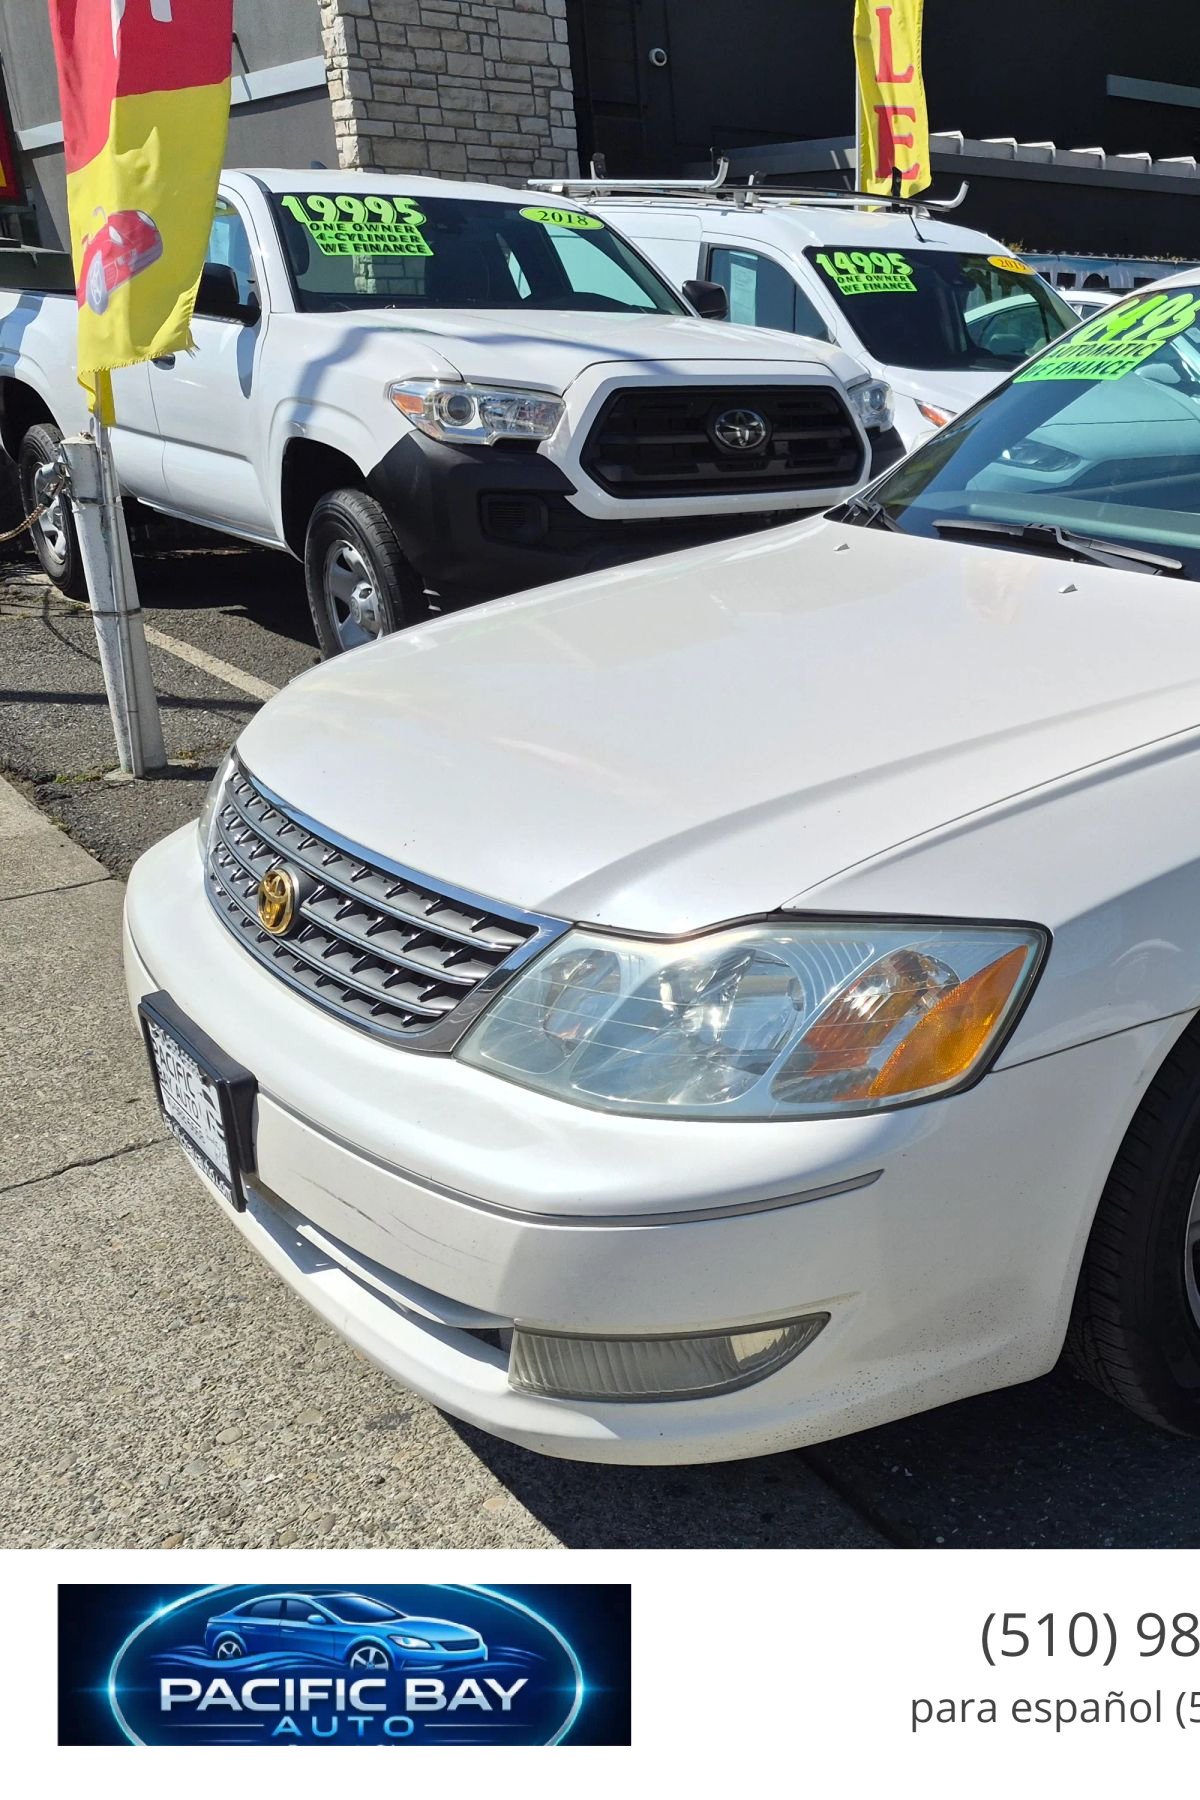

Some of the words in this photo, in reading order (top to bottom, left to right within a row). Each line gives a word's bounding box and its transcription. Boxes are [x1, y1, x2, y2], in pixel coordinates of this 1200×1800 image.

[281, 195, 427, 226] 19995
[537, 210, 589, 226] 2018
[310, 222, 347, 232] ONE
[353, 222, 415, 234] OWNER
[316, 232, 421, 244] 4-CYLINDER
[320, 243, 349, 254] WE
[353, 243, 427, 255] FINANCE
[816, 251, 914, 277] 14995
[837, 275, 860, 284] ONE
[865, 274, 907, 282] OWNER
[841, 283, 860, 293] WE
[863, 282, 913, 291] FINANCE
[1050, 342, 1157, 358] AUTOMATIC
[1022, 362, 1055, 379] WE
[1051, 360, 1135, 377] FINANCE
[152, 1038, 195, 1099] PACIFIC
[175, 1083, 199, 1118] AUTO
